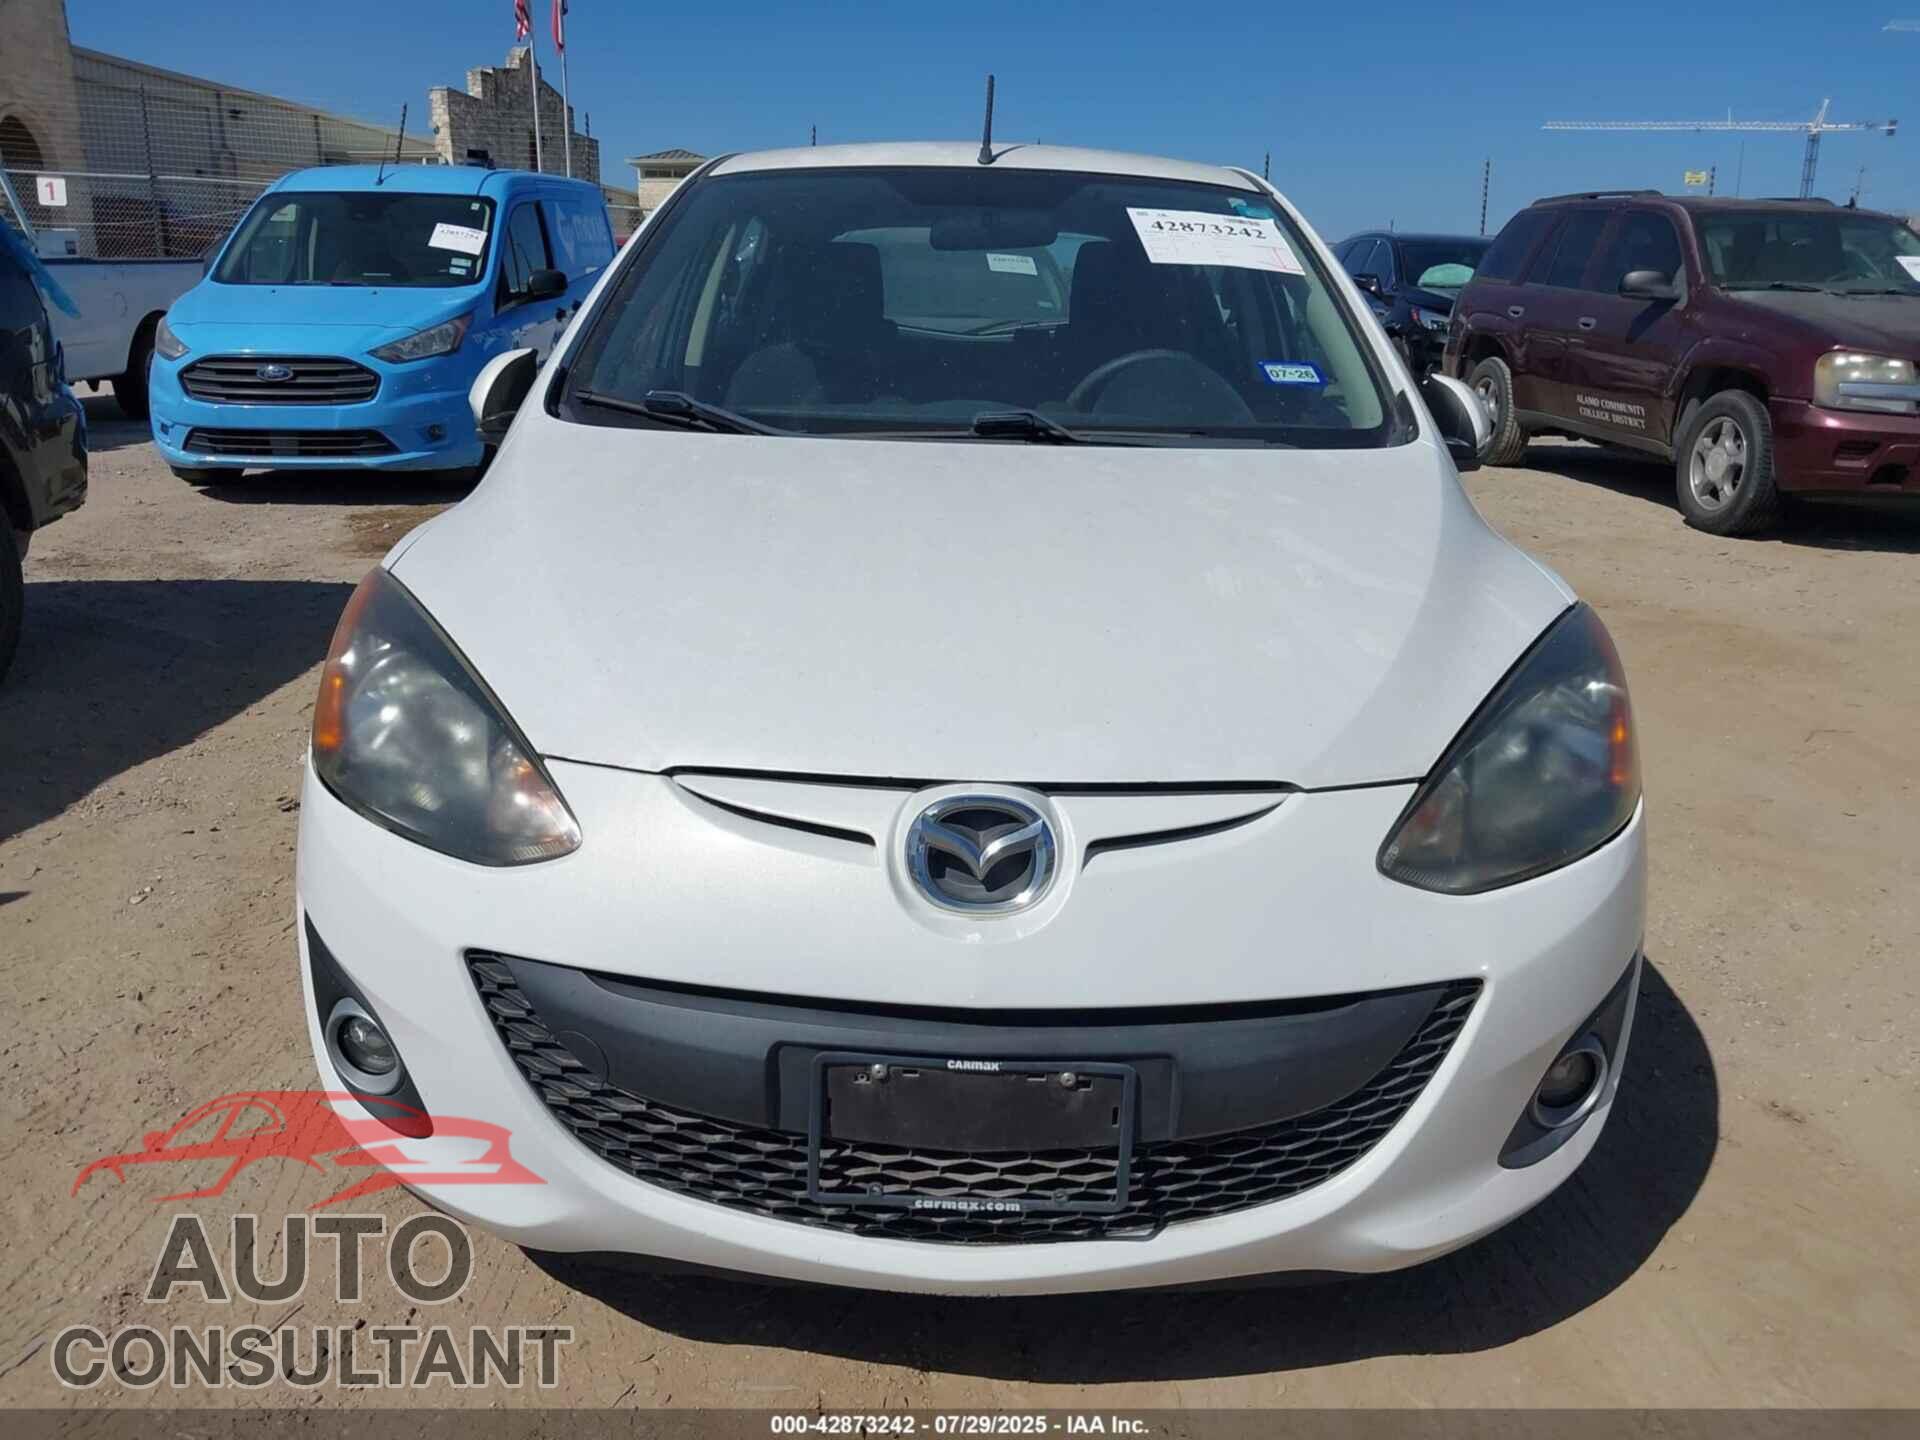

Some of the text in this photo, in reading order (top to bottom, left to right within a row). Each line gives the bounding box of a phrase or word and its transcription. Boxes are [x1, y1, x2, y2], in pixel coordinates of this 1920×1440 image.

[44, 181, 55, 201] 1
[1151, 220, 1267, 240] 42873242
[1579, 406, 1646, 430] COLLEGE DISTRICT
[1601, 399, 1645, 417] COMMUNITY
[914, 1199, 1021, 1212] carmax.com
